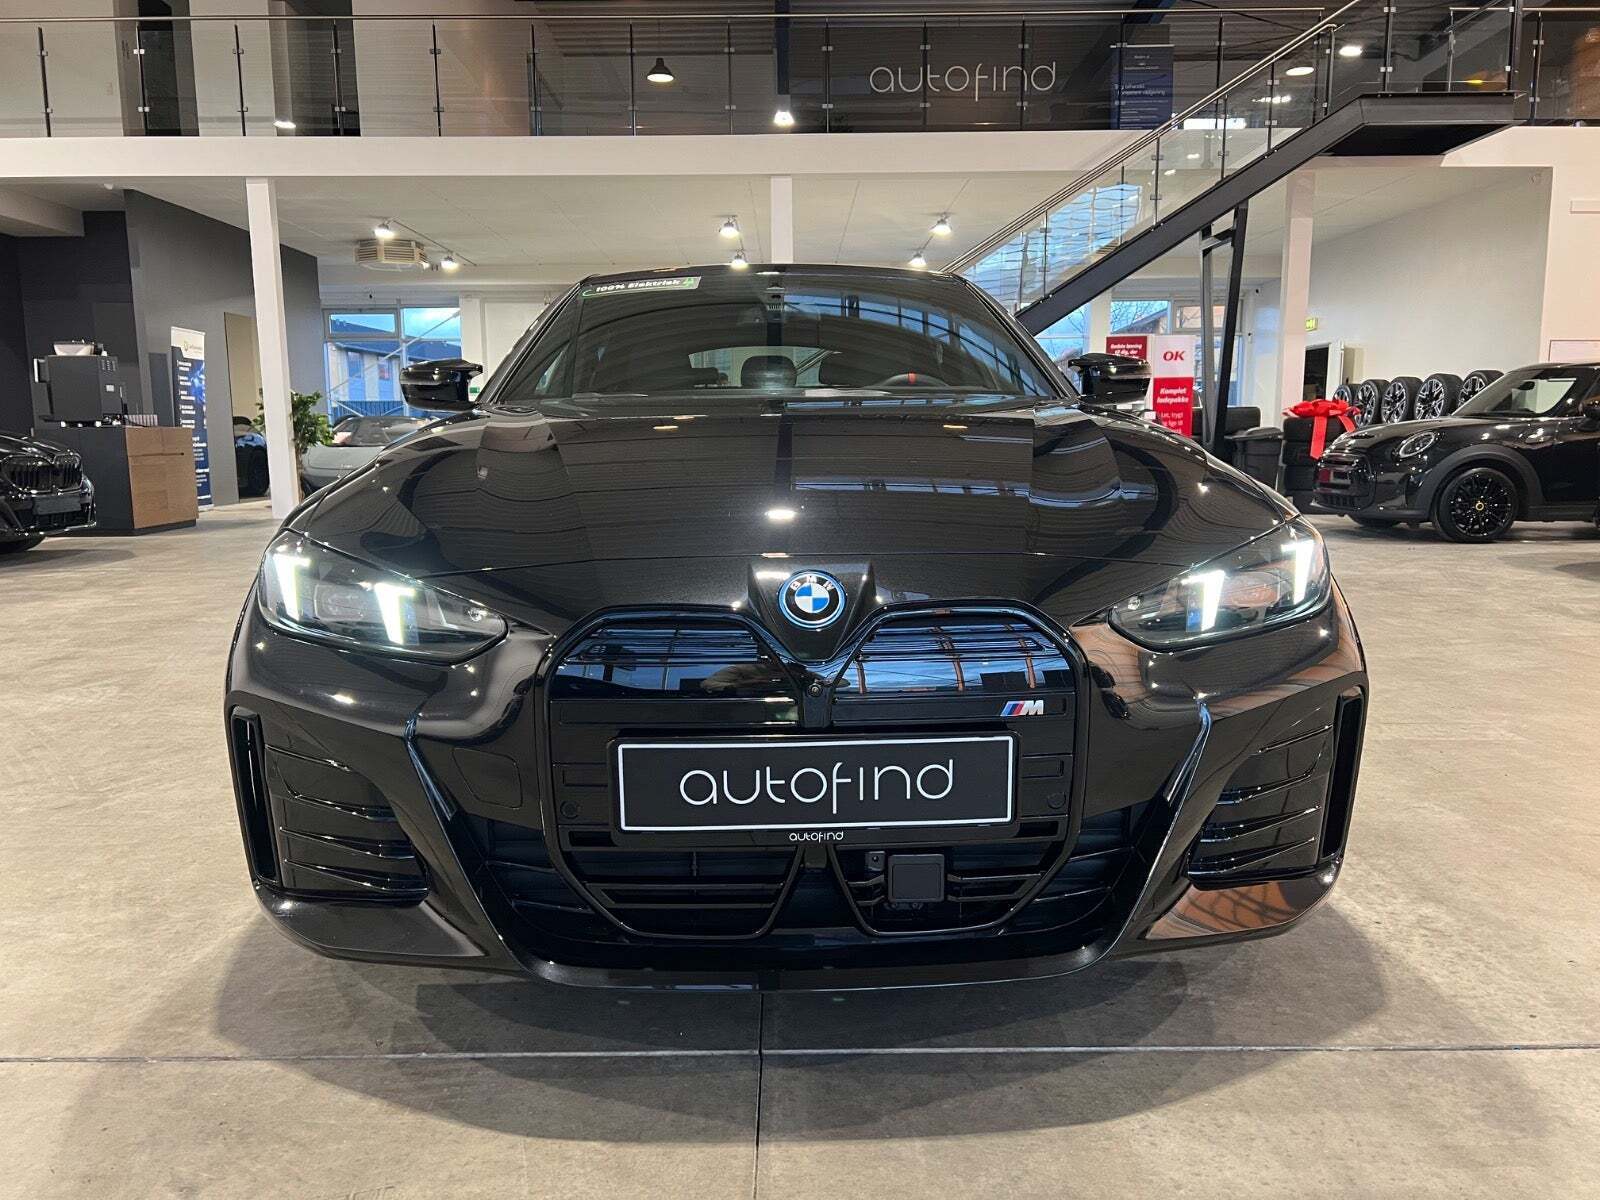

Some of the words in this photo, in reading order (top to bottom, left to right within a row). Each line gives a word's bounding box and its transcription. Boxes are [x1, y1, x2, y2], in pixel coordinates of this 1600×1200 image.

[869, 61, 1056, 102] autofind
[595, 283, 625, 293] 100%
[1163, 350, 1186, 361] OK
[1159, 386, 1187, 395] Komplet
[1156, 396, 1190, 405] ladepakke
[789, 574, 836, 591] BMW
[679, 758, 954, 814] autofind
[788, 830, 844, 843] autofind
